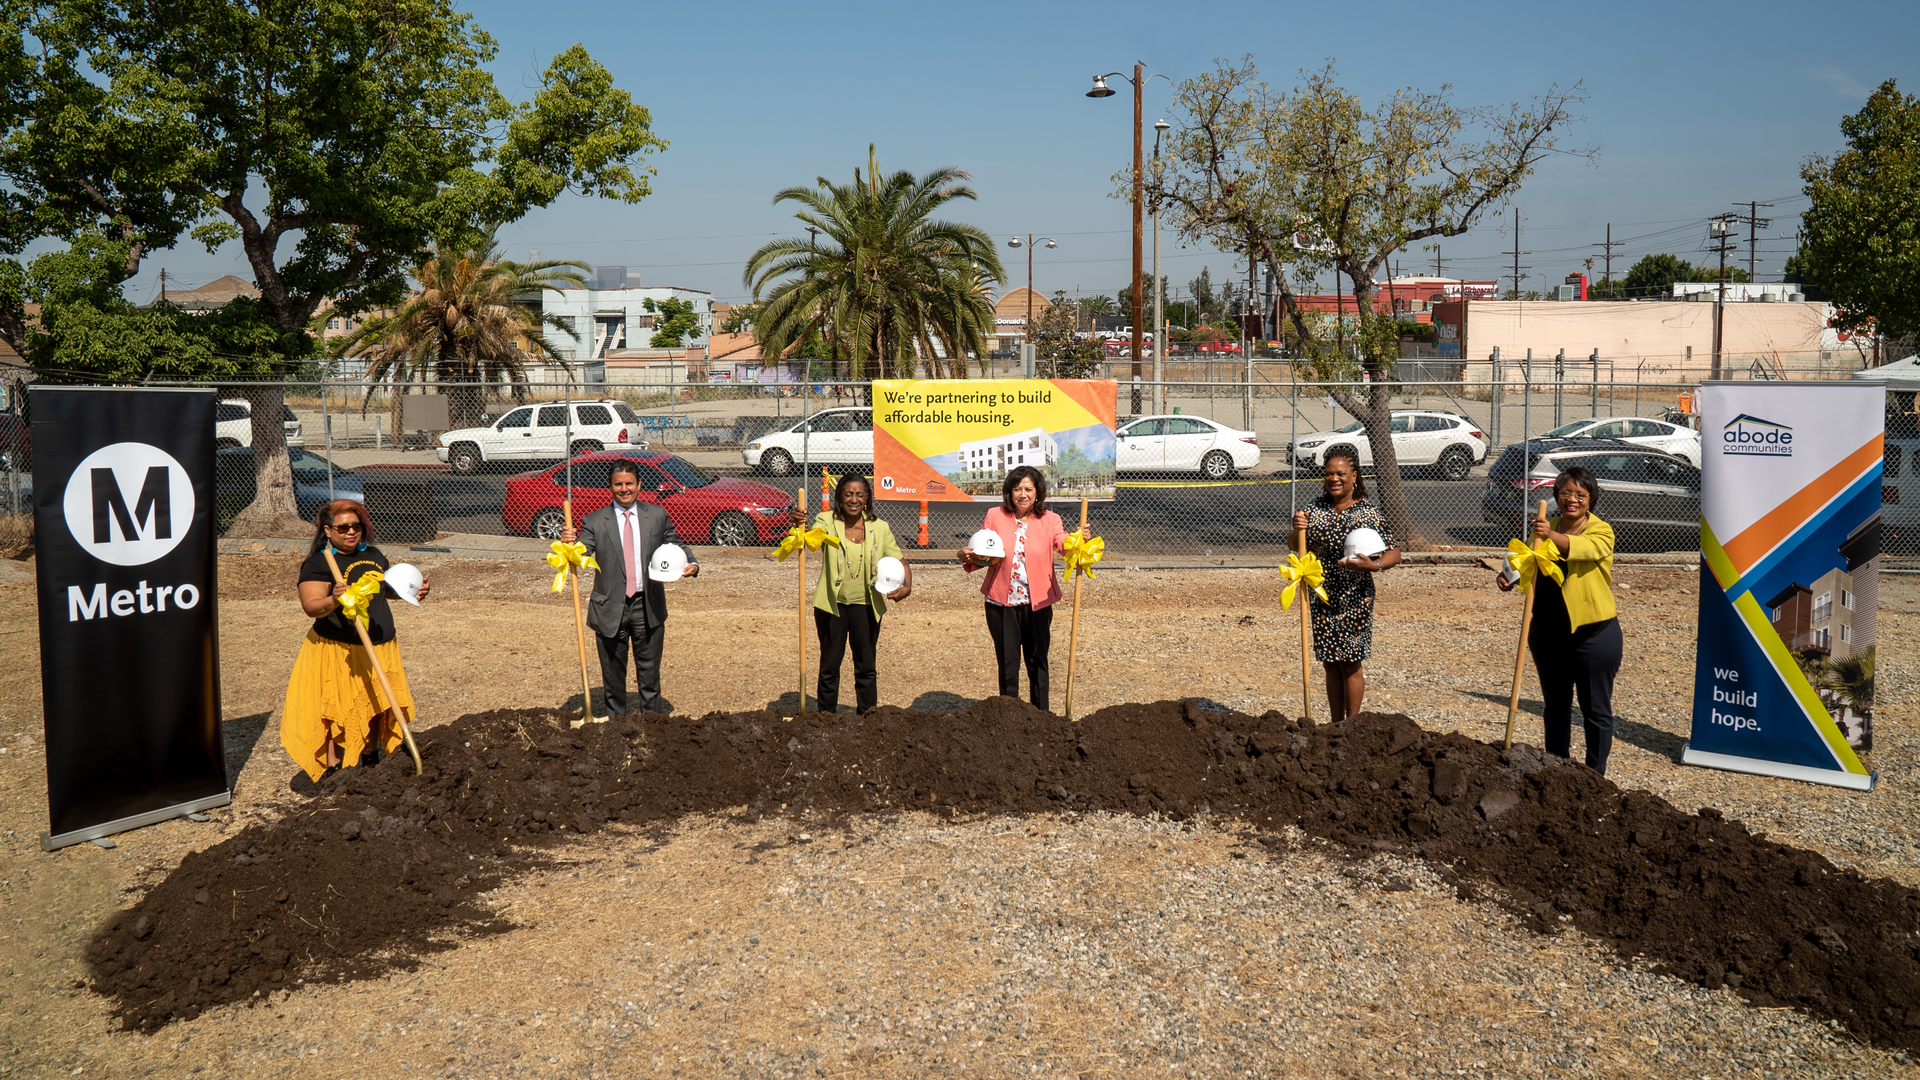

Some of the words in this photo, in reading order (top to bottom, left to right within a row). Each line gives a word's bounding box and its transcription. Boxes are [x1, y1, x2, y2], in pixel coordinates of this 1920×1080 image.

[884, 392, 922, 404] We're
[926, 391, 997, 407] partnering
[1001, 393, 1015, 404] to
[1018, 391, 1051, 404] build
[884, 410, 952, 423] affordable
[957, 410, 1014, 426] housing.
[1724, 423, 1793, 444] abode
[1723, 444, 1793, 453] communities
[883, 479, 893, 487] M
[90, 466, 172, 544] M
[67, 580, 200, 622] Metro
[1714, 667, 1739, 682] we
[1713, 685, 1757, 708] build
[1711, 708, 1761, 731] hope.
